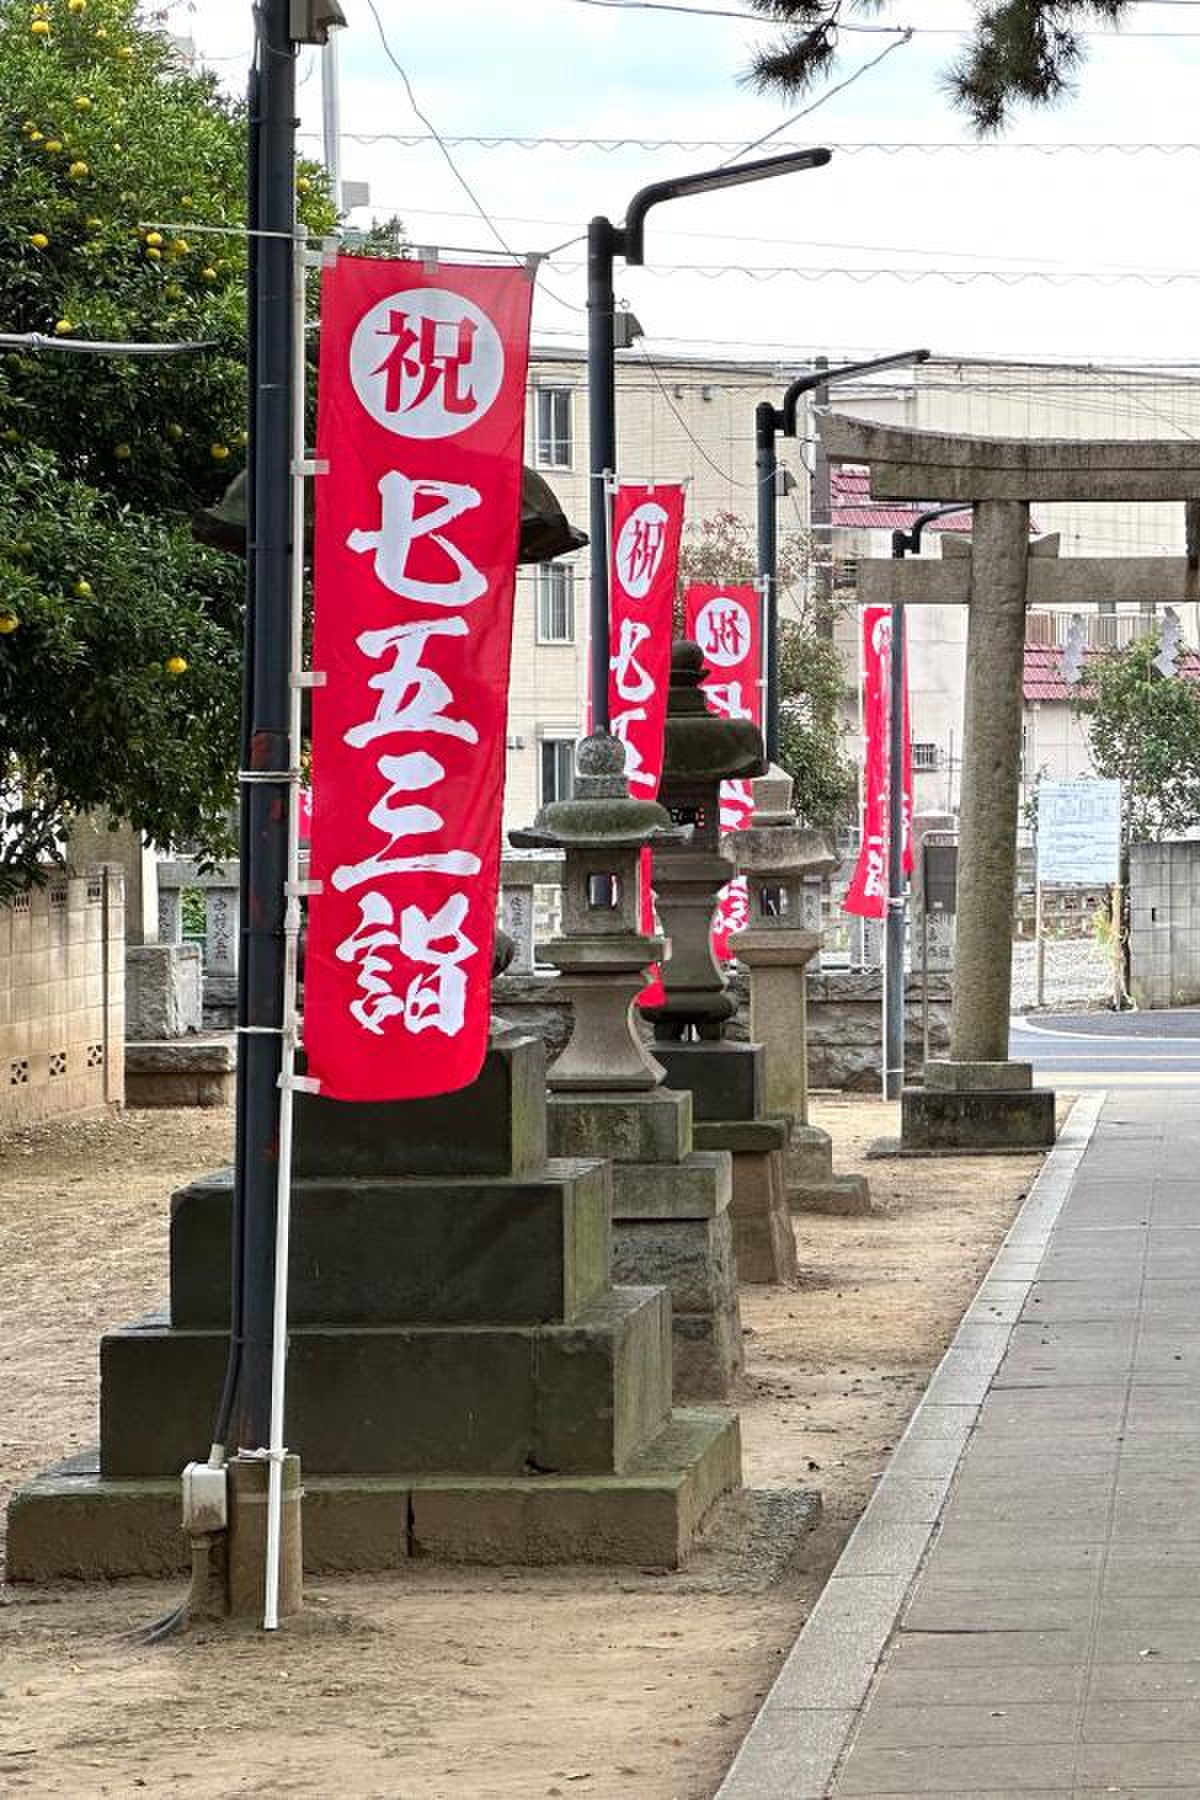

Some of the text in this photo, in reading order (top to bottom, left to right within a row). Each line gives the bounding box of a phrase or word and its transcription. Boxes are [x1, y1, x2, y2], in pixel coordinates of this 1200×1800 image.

[371, 310, 477, 416] 祝
[625, 520, 665, 584] 祝
[331, 469, 489, 1038] 七五三詣
